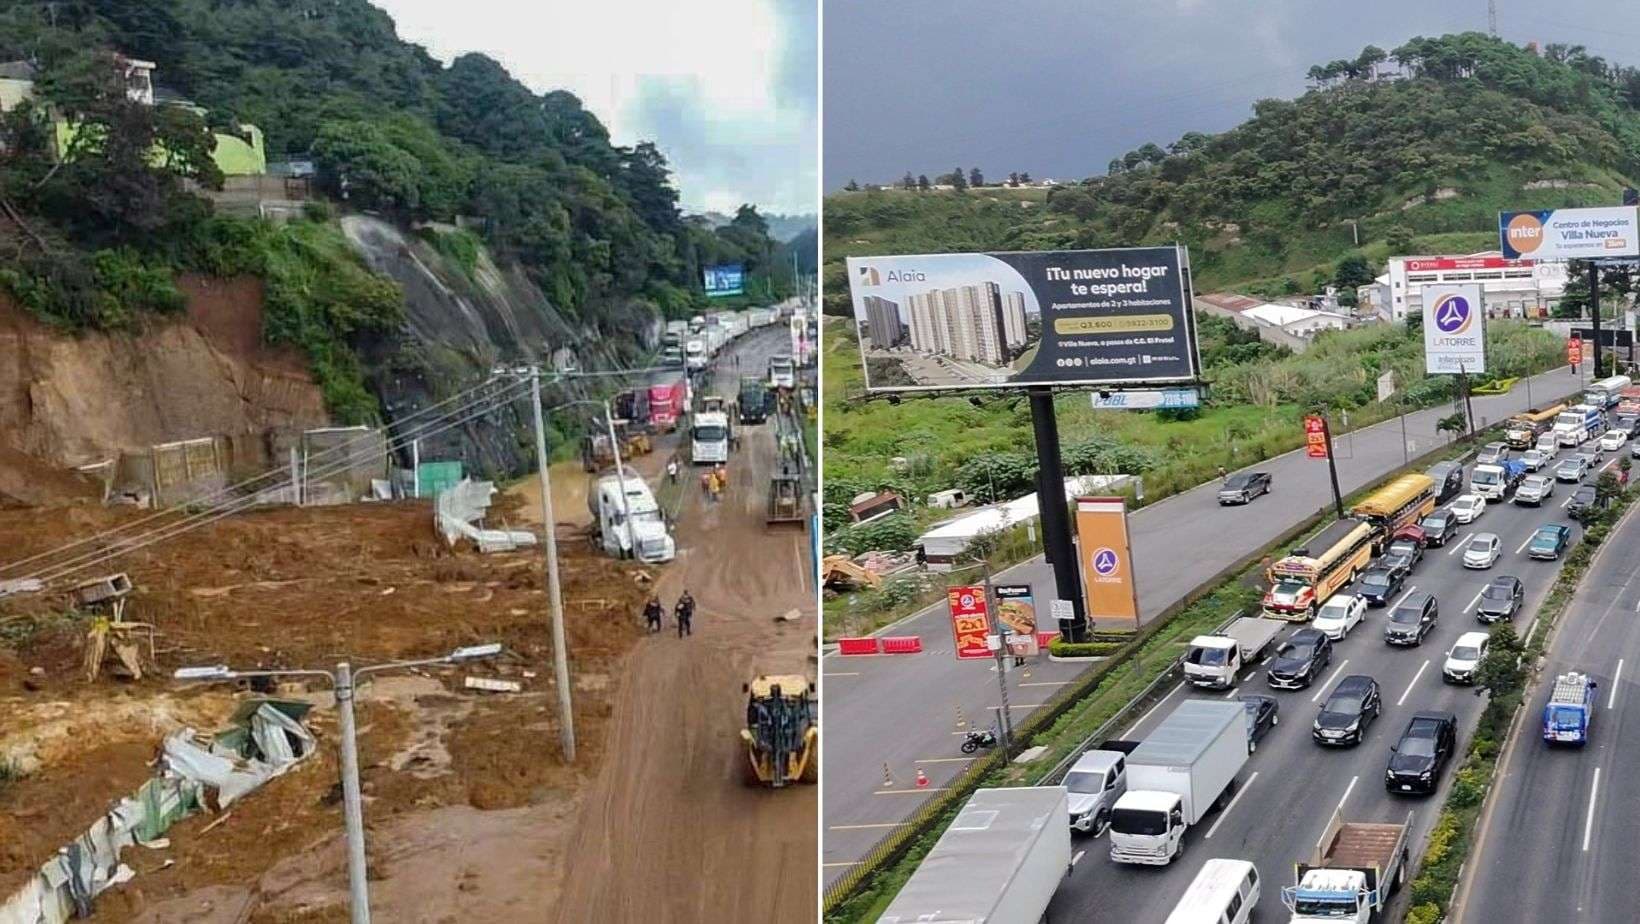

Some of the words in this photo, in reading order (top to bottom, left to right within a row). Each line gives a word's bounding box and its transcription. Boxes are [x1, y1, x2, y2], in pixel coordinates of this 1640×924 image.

[1553, 221, 1579, 229] Centro
[1580, 220, 1591, 228] de
[1592, 218, 1629, 227] Negocios
[1510, 225, 1541, 238] inter
[1561, 230, 1583, 240] Villa
[1585, 229, 1618, 239] Nueva
[887, 269, 926, 282] Alaia
[1046, 267, 1071, 280] ¡Tu
[1073, 267, 1119, 280] nuevo
[1121, 264, 1168, 280] hogar
[1070, 283, 1088, 295] te
[1090, 280, 1147, 297] espera!
[1051, 302, 1100, 310] Apartamentos
[1128, 299, 1171, 307] habitaciones
[1090, 356, 1136, 365] alaia.com.gt
[960, 618, 984, 631] 2x1
